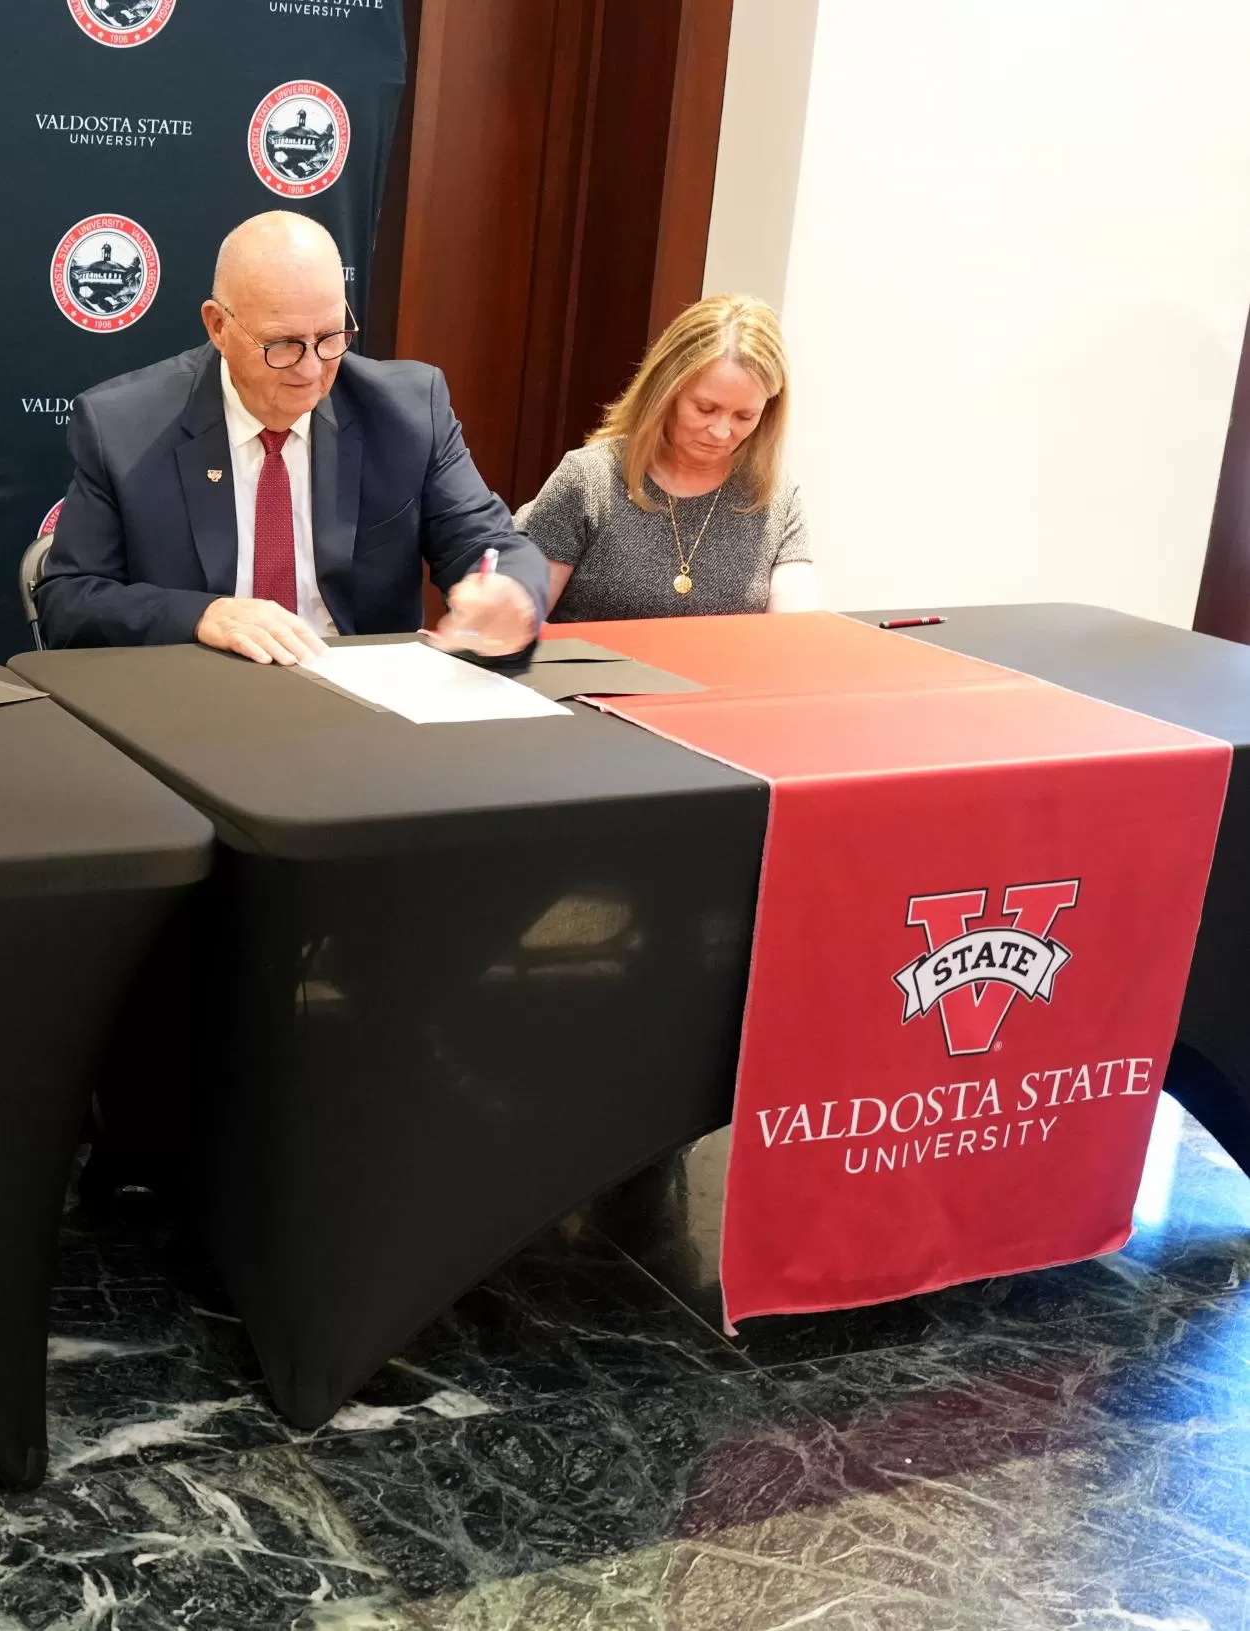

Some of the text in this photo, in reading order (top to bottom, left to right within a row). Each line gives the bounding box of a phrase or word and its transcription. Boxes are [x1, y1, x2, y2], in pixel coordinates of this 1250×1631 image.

[270, 1, 350, 18] UNIVERSITY
[110, 34, 128, 44] 1906
[36, 114, 192, 136] VALDOSTA STATE
[69, 133, 156, 147] UNIVERSITY
[54, 218, 157, 308] VALDOSTA STATE UNIVERSITY VALDOSTA GEORGIA
[94, 320, 112, 328] 1906
[932, 942, 1038, 986] STATE
[756, 1057, 1153, 1148] VALDOSTA STATE
[845, 1117, 1058, 1174] UNIVERSITY
